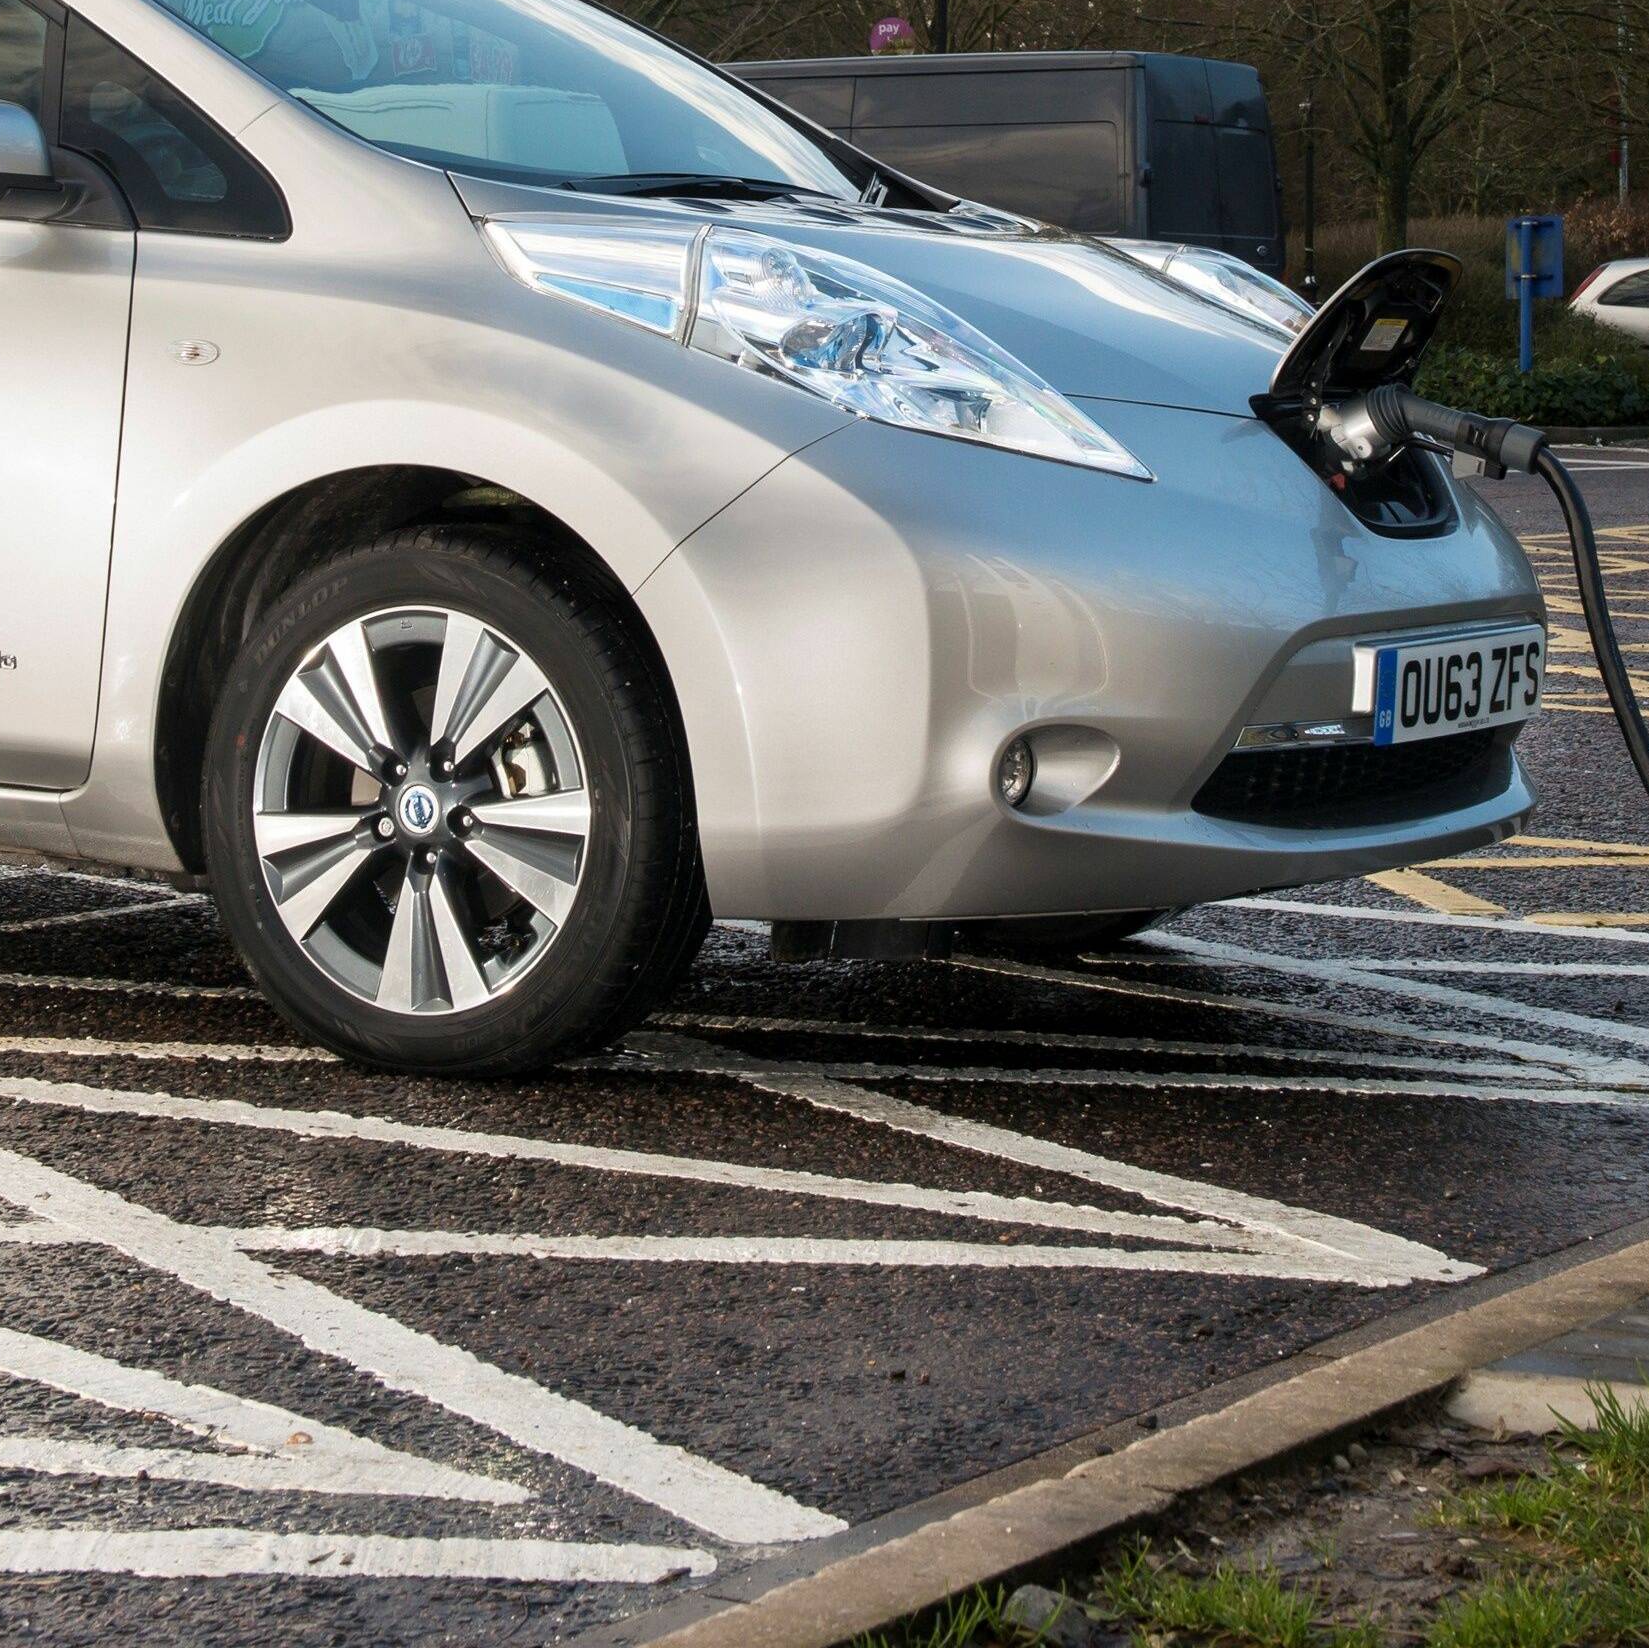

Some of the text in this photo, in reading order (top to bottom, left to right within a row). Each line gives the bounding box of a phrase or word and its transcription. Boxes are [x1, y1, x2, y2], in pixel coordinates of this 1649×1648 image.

[878, 23, 900, 36] pay
[1400, 641, 1540, 728] OU63 ZFS
[1379, 709, 1392, 728] GB
